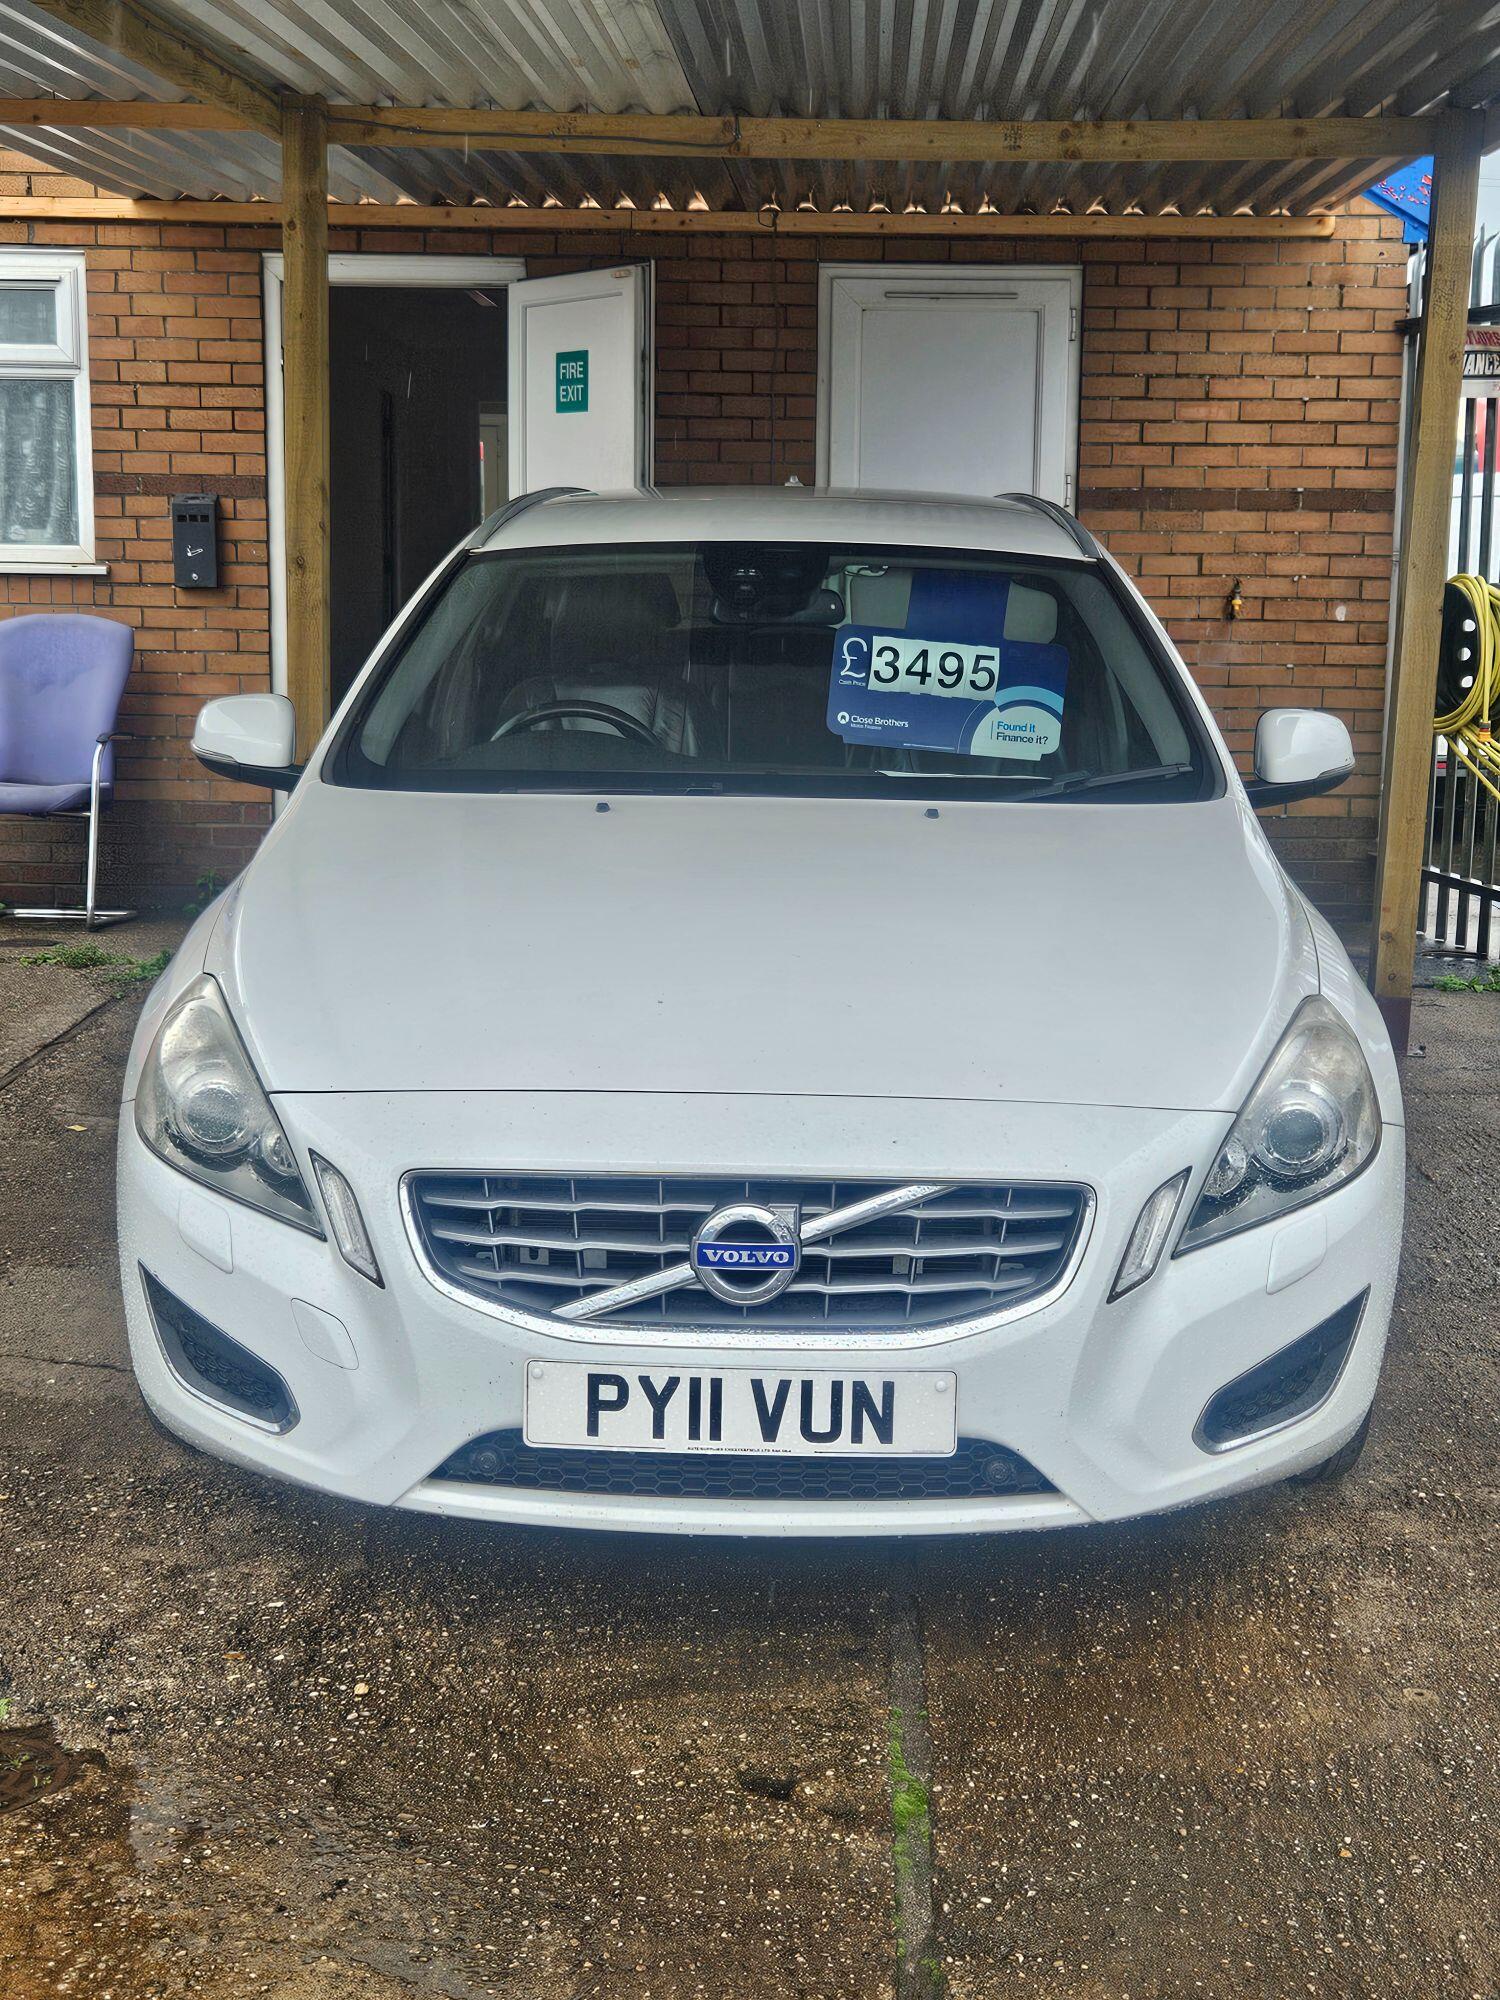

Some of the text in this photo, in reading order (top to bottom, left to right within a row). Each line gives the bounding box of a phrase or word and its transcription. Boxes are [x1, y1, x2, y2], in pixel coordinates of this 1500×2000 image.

[1465, 330, 1500, 346] YLORS
[560, 361, 584, 380] FIRE
[1463, 353, 1500, 375] ANCE
[560, 384, 584, 402] EXIT
[851, 715, 909, 728] Close Brothers
[997, 720, 1028, 732] Found
[996, 732, 1049, 745] Finance it?
[702, 1249, 790, 1263] VOLVO
[750, 1378, 895, 1445] VUN
